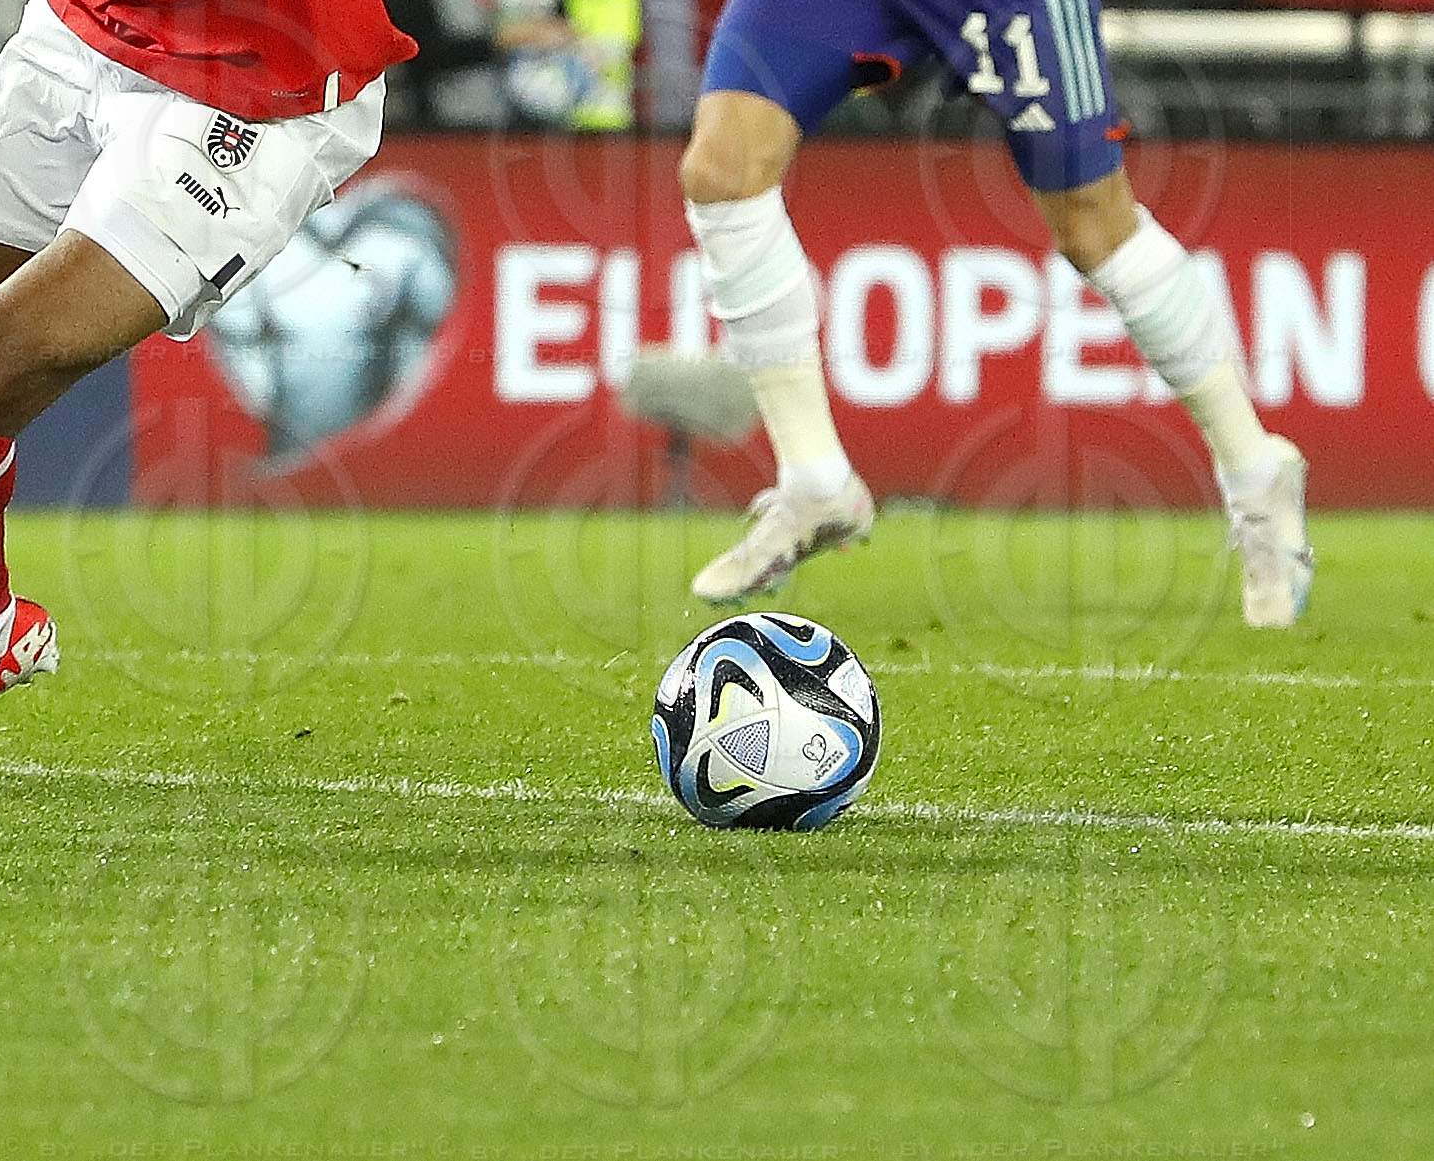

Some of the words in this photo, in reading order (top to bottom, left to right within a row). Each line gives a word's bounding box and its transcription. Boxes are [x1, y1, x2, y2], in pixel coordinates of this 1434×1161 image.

[960, 12, 1050, 97] 11
[175, 172, 222, 216] PUMA
[493, 244, 1367, 408] EUOPEN
